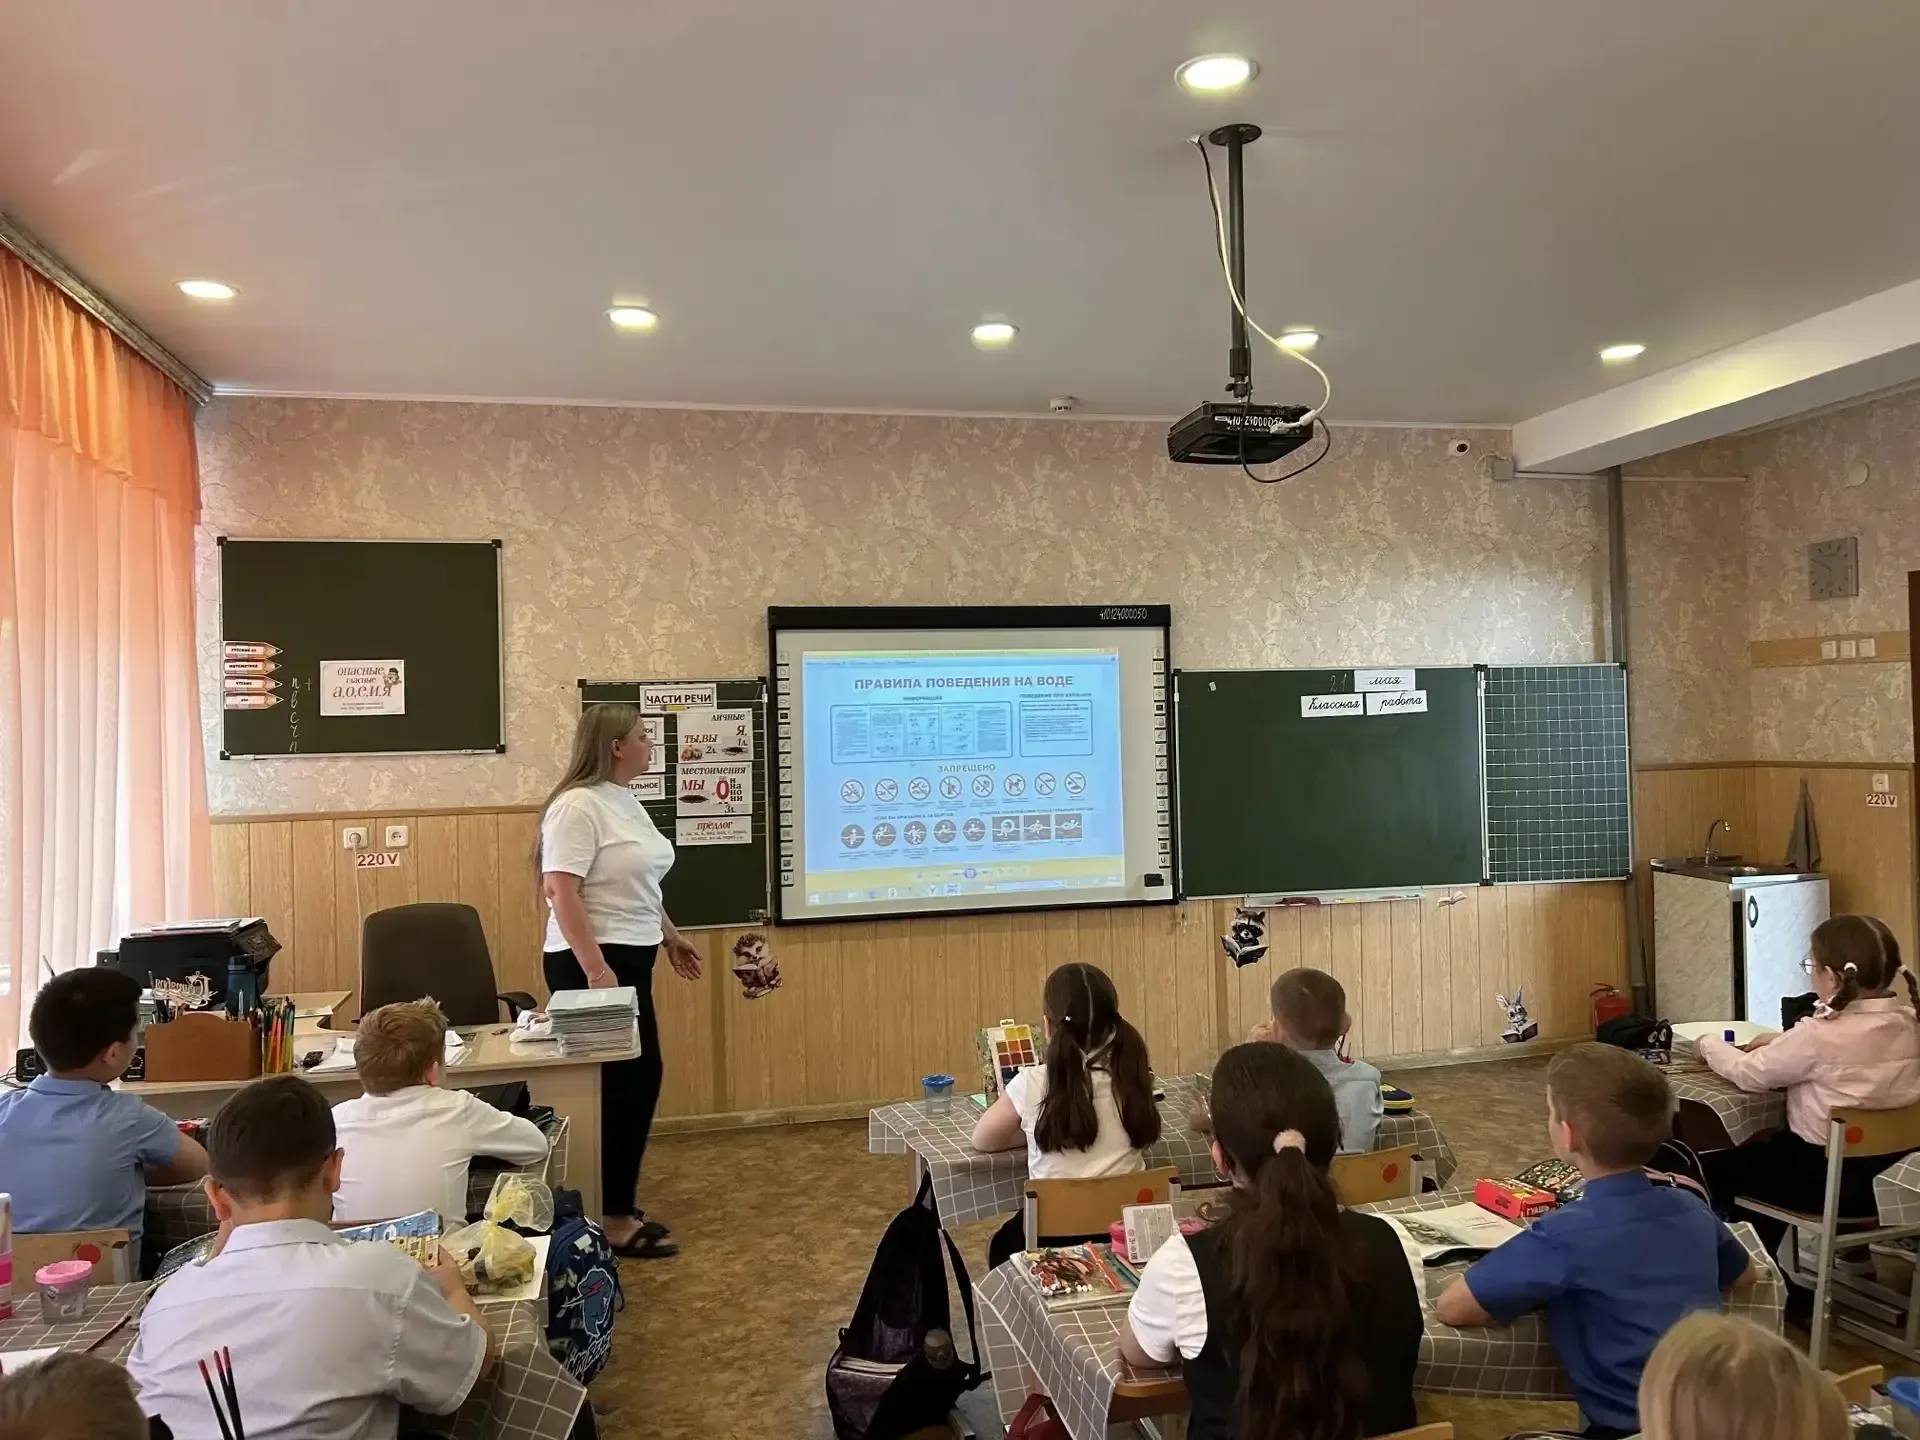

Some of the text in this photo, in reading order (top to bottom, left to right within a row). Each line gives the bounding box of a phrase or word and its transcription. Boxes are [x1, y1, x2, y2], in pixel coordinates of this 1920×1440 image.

[854, 675, 1074, 689] ПРАВИЛА ПОВЕДЕНИЯ НА ВОДЕ
[1369, 676, 1402, 685] мая
[646, 694, 712, 704] ЧАСТИ РЕЧИ
[1308, 692, 1423, 711] Классная работа
[937, 764, 996, 773] ЗАПРЕЩЕНО
[681, 779, 705, 791] МЫ
